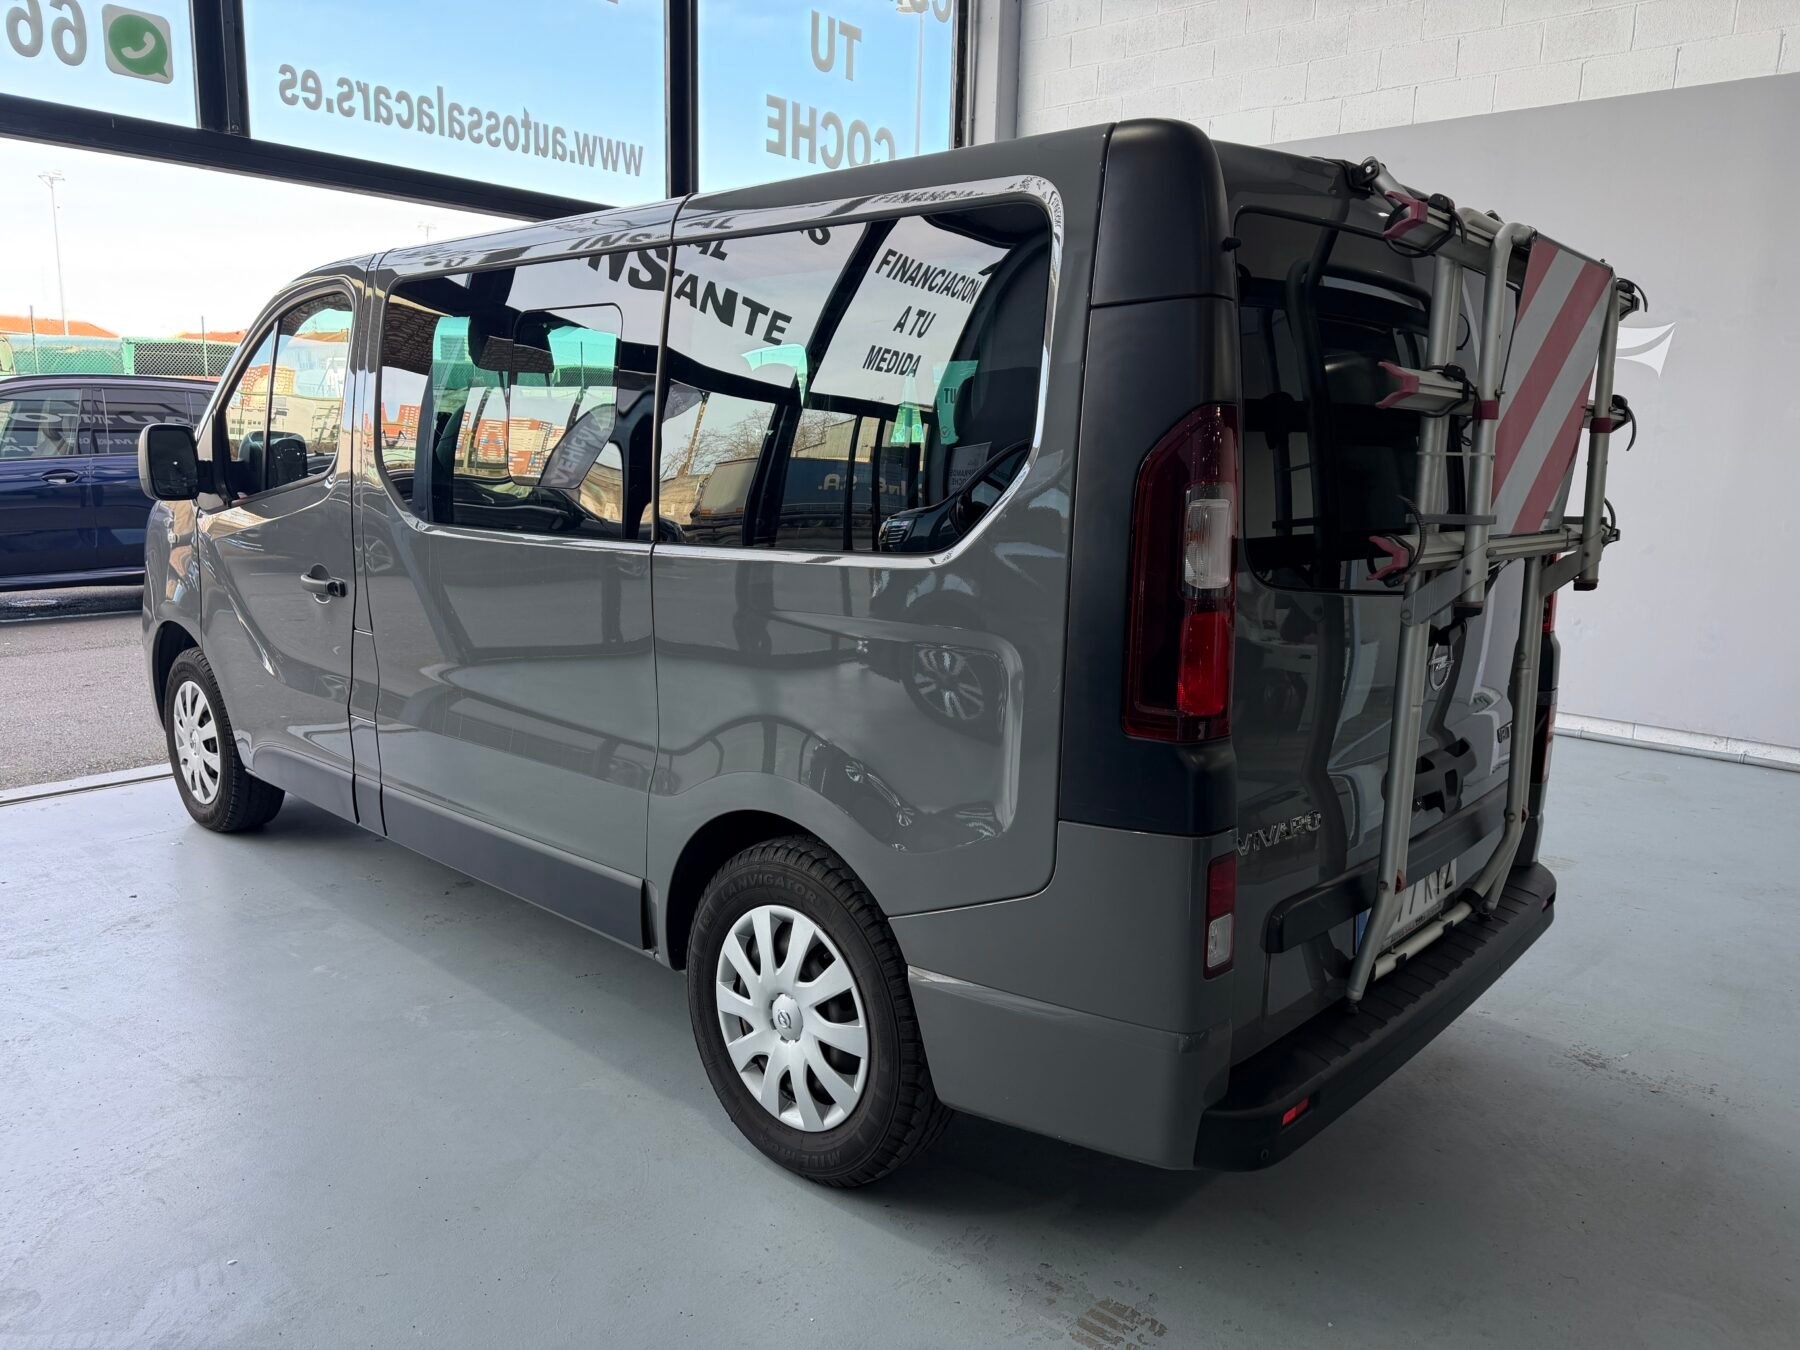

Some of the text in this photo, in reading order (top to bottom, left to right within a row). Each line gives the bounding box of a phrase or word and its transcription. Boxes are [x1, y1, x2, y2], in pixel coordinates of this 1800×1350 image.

[875, 248, 983, 304] FINANCIACION
[893, 305, 936, 338] A TU
[862, 344, 922, 378] MEDIDA
[1237, 809, 1322, 857] VIVARO
